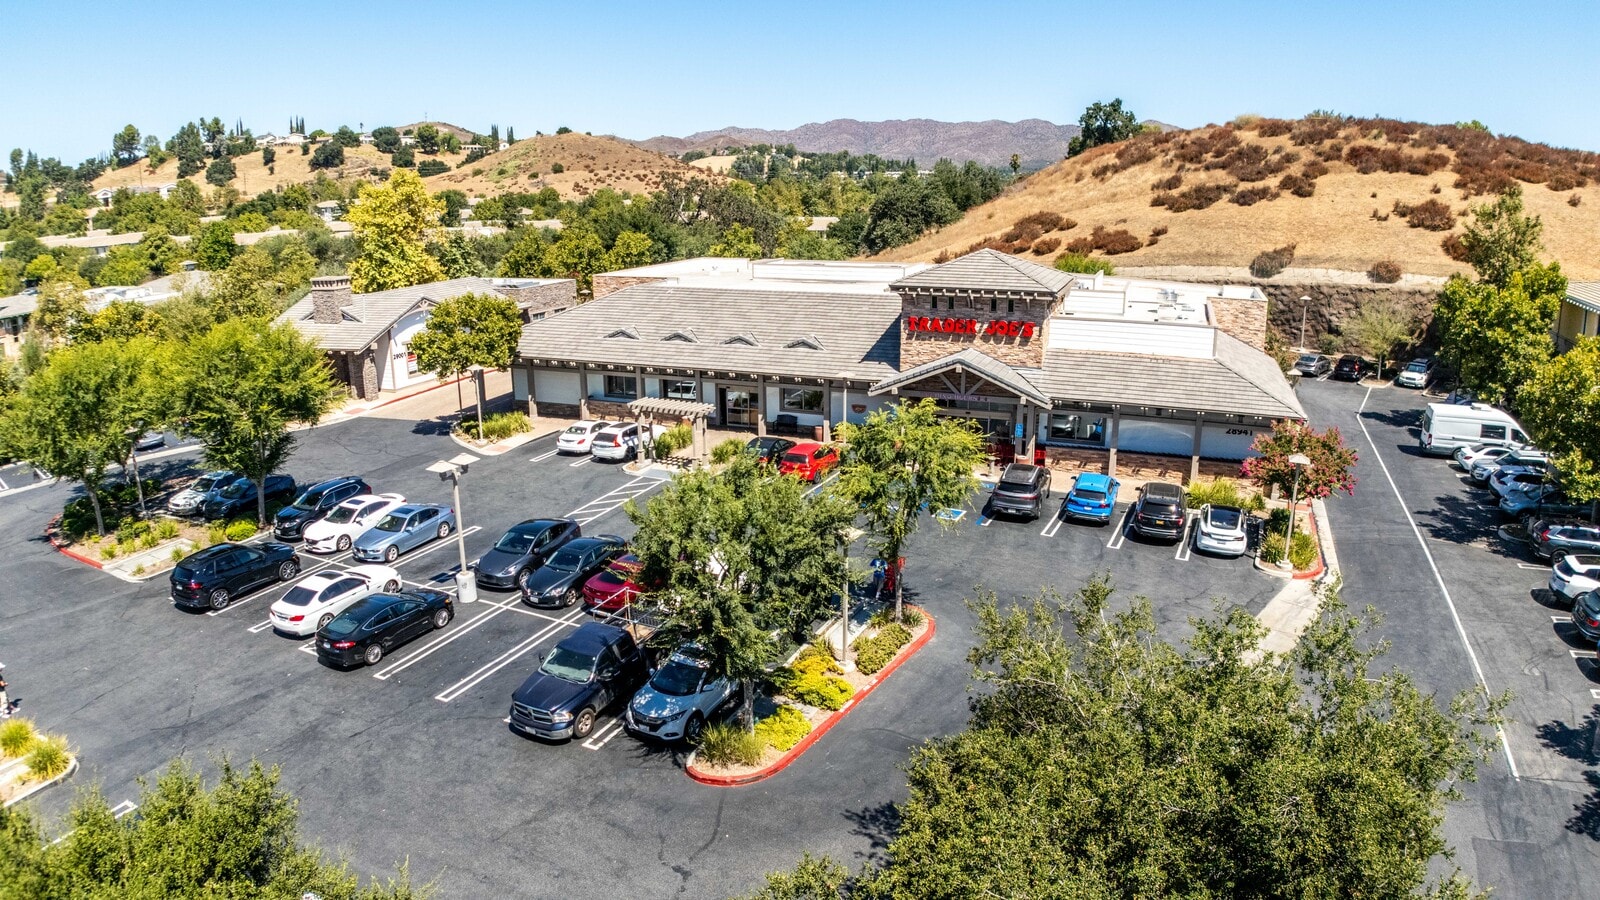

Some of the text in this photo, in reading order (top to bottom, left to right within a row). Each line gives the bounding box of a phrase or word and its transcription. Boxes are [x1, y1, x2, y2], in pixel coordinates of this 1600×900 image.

[908, 316, 1036, 337] TRADER JOE'S
[1226, 428, 1253, 436] 28941
